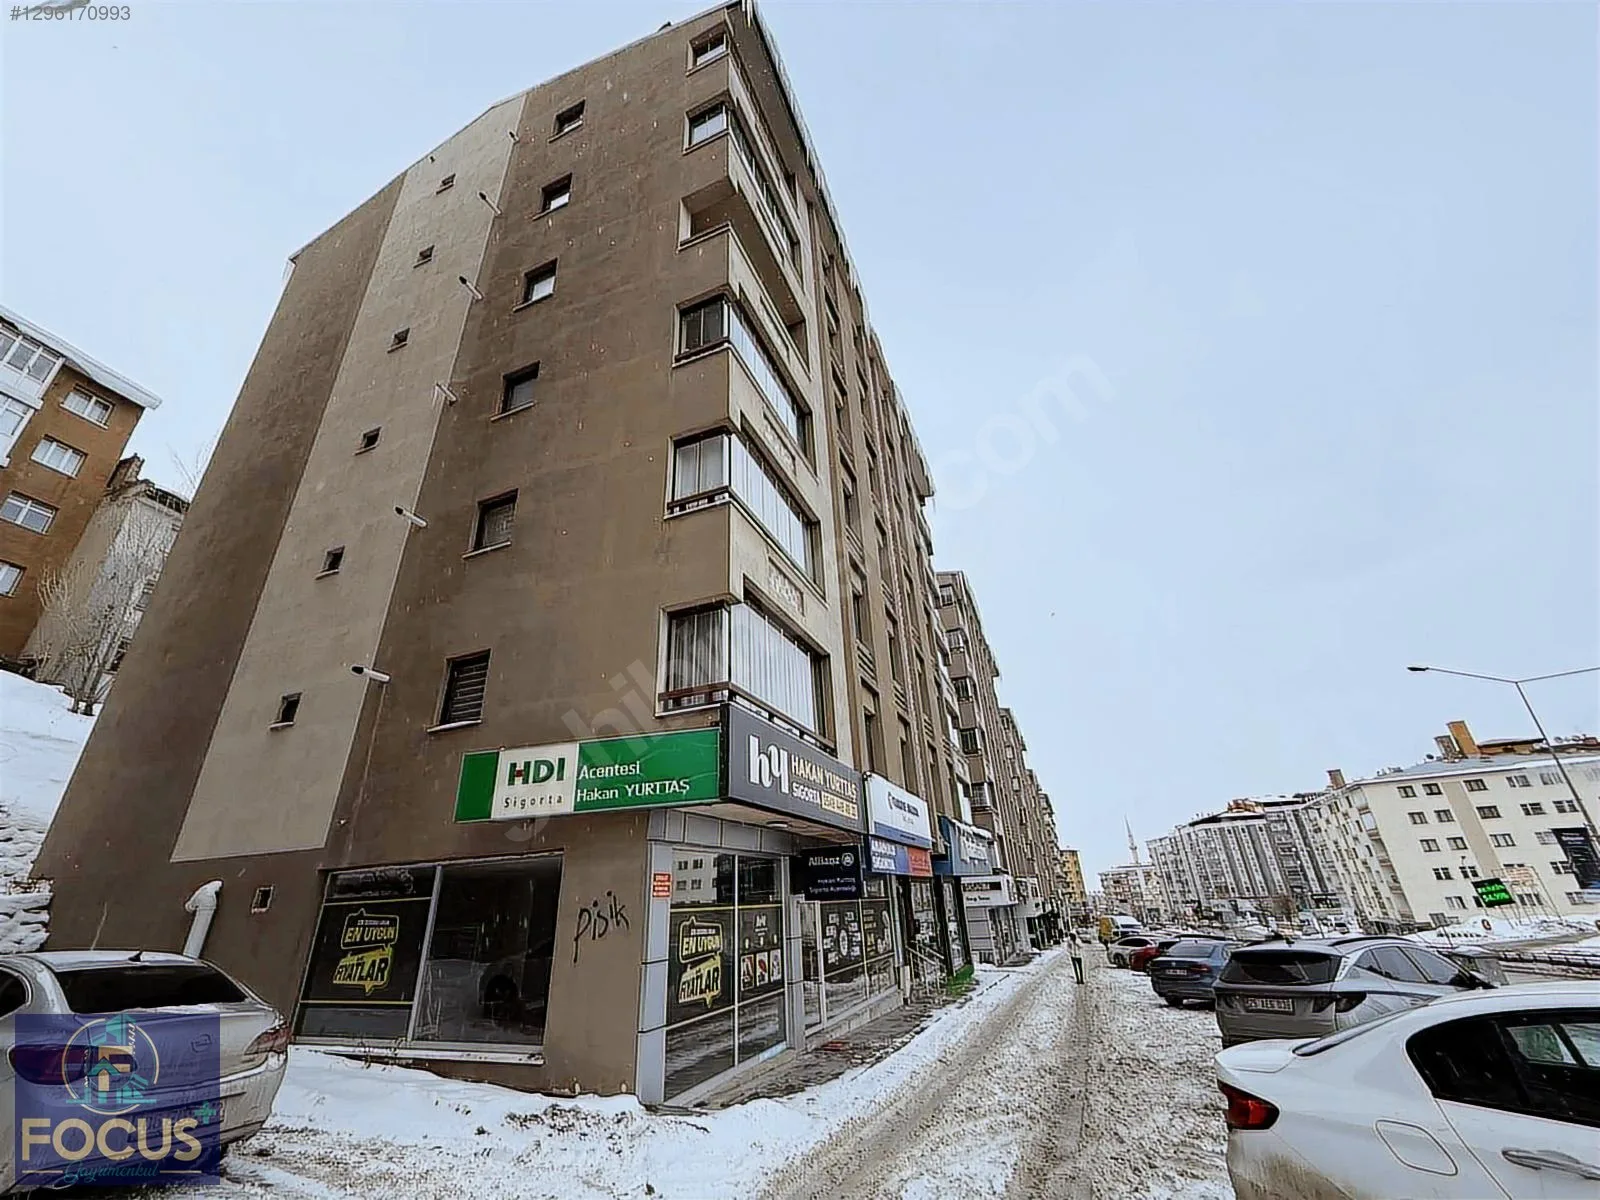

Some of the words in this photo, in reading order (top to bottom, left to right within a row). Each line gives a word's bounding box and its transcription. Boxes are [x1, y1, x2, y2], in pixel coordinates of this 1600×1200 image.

[507, 757, 566, 786] HDI
[578, 760, 641, 781] Acentesi
[791, 755, 823, 786] HAKAN
[576, 788, 619, 803] Hakan
[625, 778, 690, 797] YURTTAŞ
[503, 794, 563, 810] Sigorta
[808, 856, 840, 867] Allianz
[344, 927, 363, 943] EN
[682, 936, 697, 956] EN
